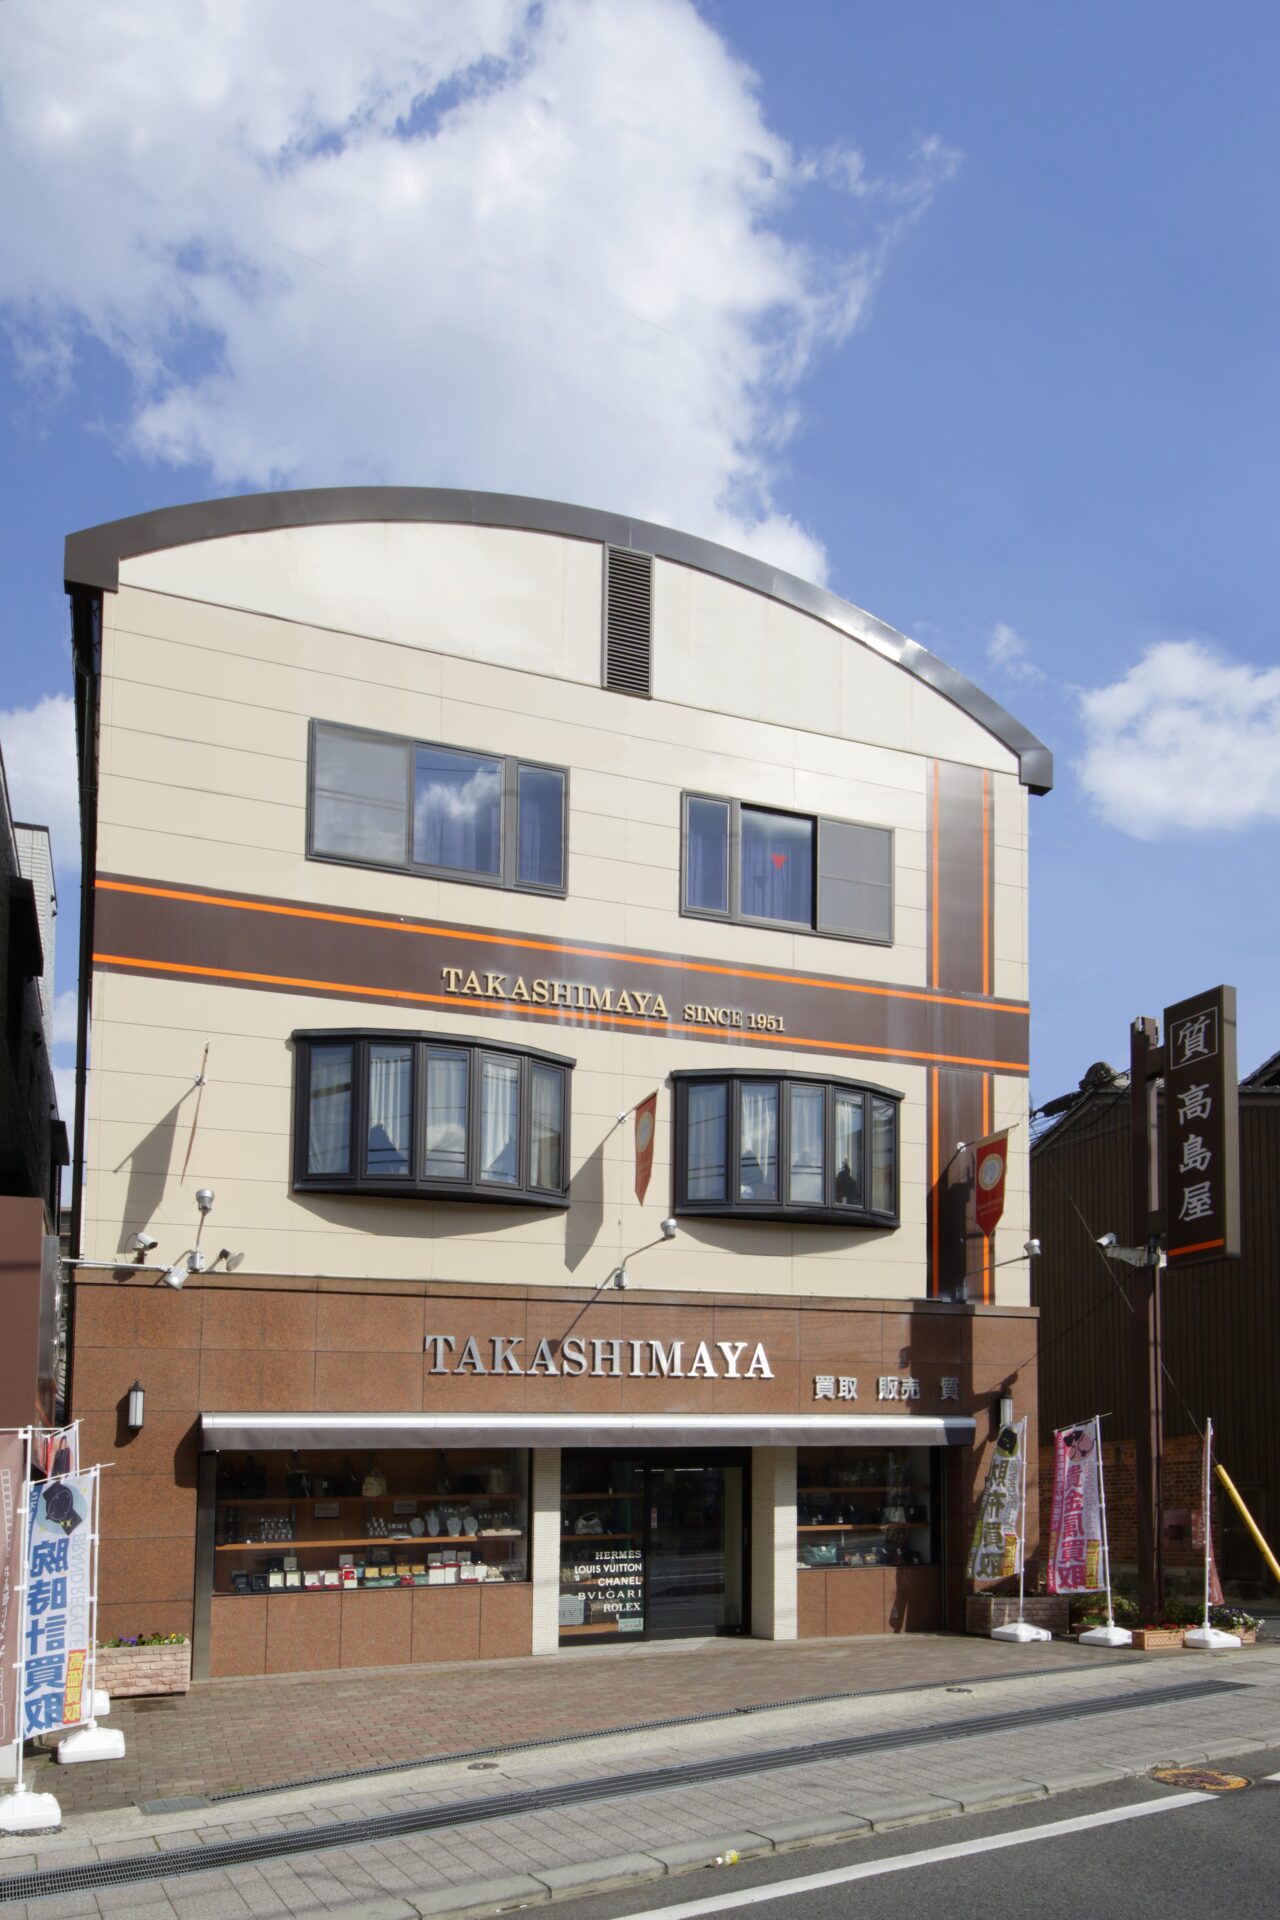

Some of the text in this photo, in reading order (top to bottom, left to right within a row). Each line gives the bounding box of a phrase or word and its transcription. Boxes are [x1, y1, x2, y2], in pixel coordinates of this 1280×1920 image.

[443, 968, 669, 1018] TAKASHIMAYA
[683, 1004, 785, 1032] SINCE 1951
[1177, 1016, 1211, 1063] 質
[1177, 1083, 1214, 1222] 高島屋
[424, 1335, 774, 1378] TAKASHIMAYA
[813, 1375, 960, 1400] 買取 販売 質
[575, 1563, 642, 1574] LOUIS VUITTON
[598, 1577, 642, 1587] CHANEL
[603, 1603, 641, 1612] ROLEX
